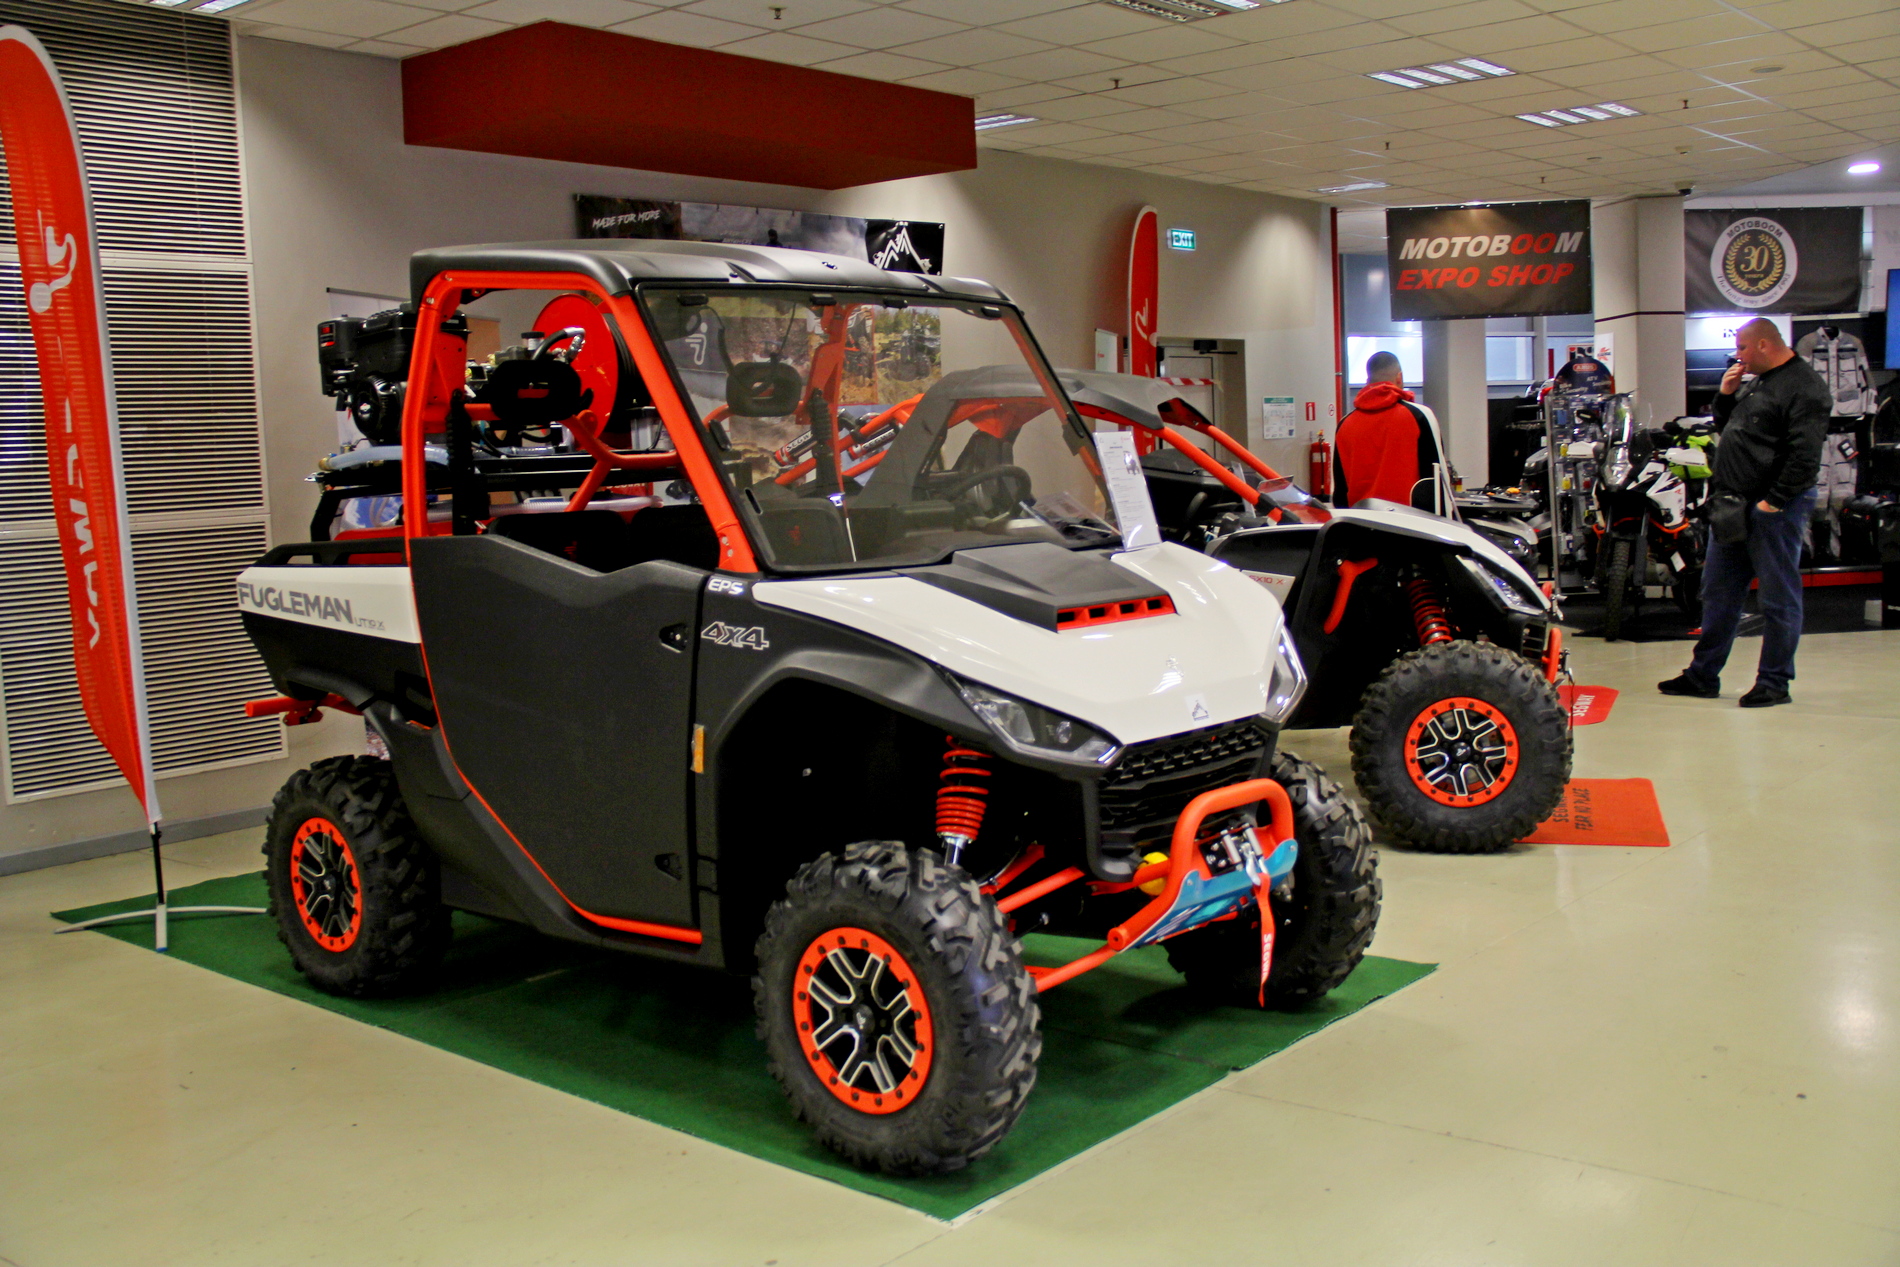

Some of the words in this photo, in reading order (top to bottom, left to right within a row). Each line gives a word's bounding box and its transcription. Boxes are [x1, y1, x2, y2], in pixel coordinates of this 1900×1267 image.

[592, 216, 616, 229] MADE
[617, 213, 636, 225] FOR
[638, 210, 661, 223] MORE
[1726, 220, 1784, 239] MOTOBOOM
[1172, 231, 1194, 247] EXIT
[1398, 231, 1584, 260] MOTOBOOM
[1740, 245, 1770, 272] 30
[1396, 266, 1481, 290] EXPO
[1486, 263, 1575, 287] SHOP
[708, 578, 744, 595] EPS
[237, 582, 354, 624] FUGLEMAN
[1569, 694, 1595, 717] SEGWAY
[1552, 797, 1569, 823] SEGW
[1263, 933, 1272, 982] SEGW
